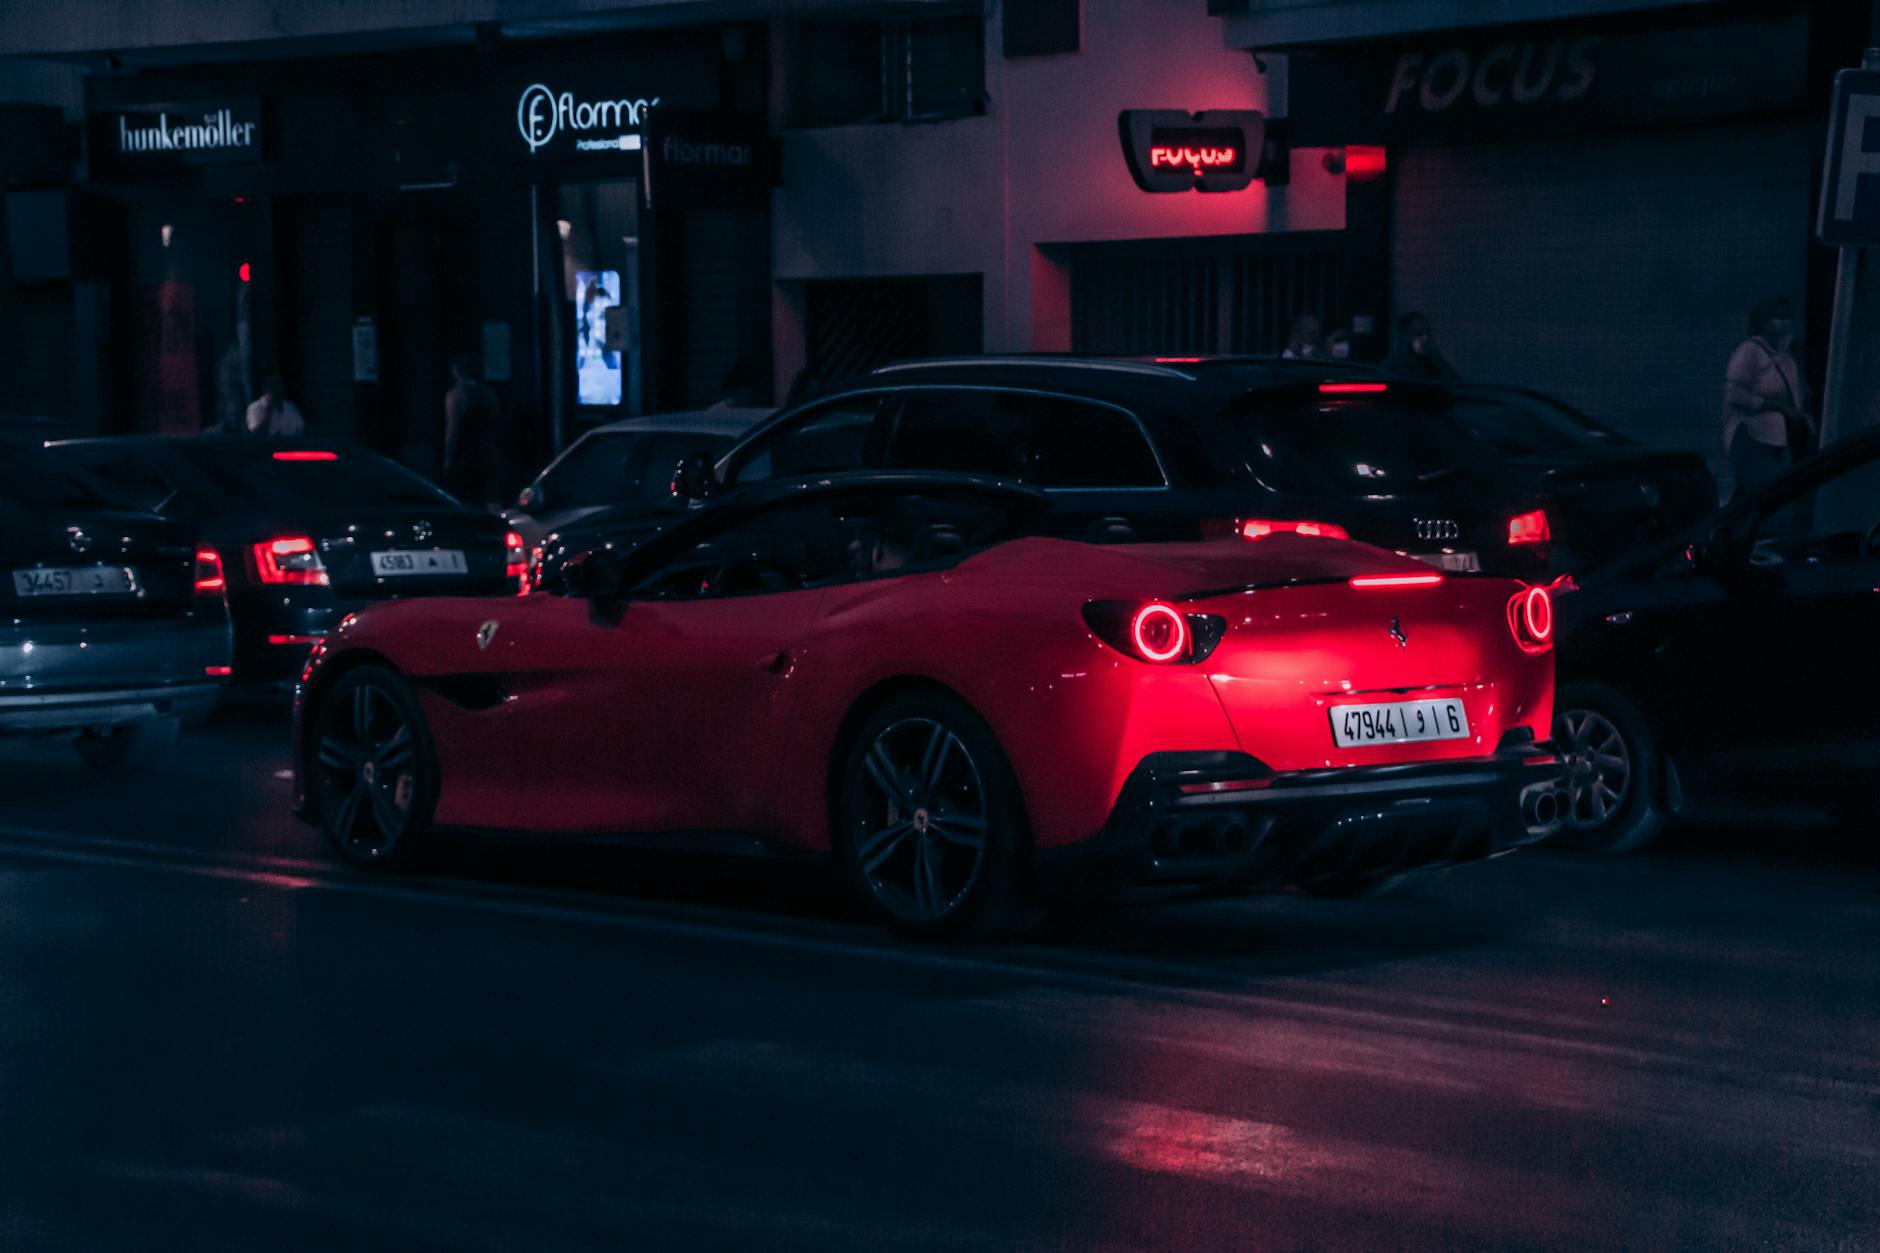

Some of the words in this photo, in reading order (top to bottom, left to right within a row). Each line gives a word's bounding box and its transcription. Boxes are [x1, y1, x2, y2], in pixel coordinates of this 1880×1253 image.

[1383, 40, 1596, 114] FOCUS
[119, 108, 256, 152] hunkemöller
[662, 136, 752, 165] flormar
[1344, 708, 1396, 741] 47944
[1446, 705, 1461, 733] 6
